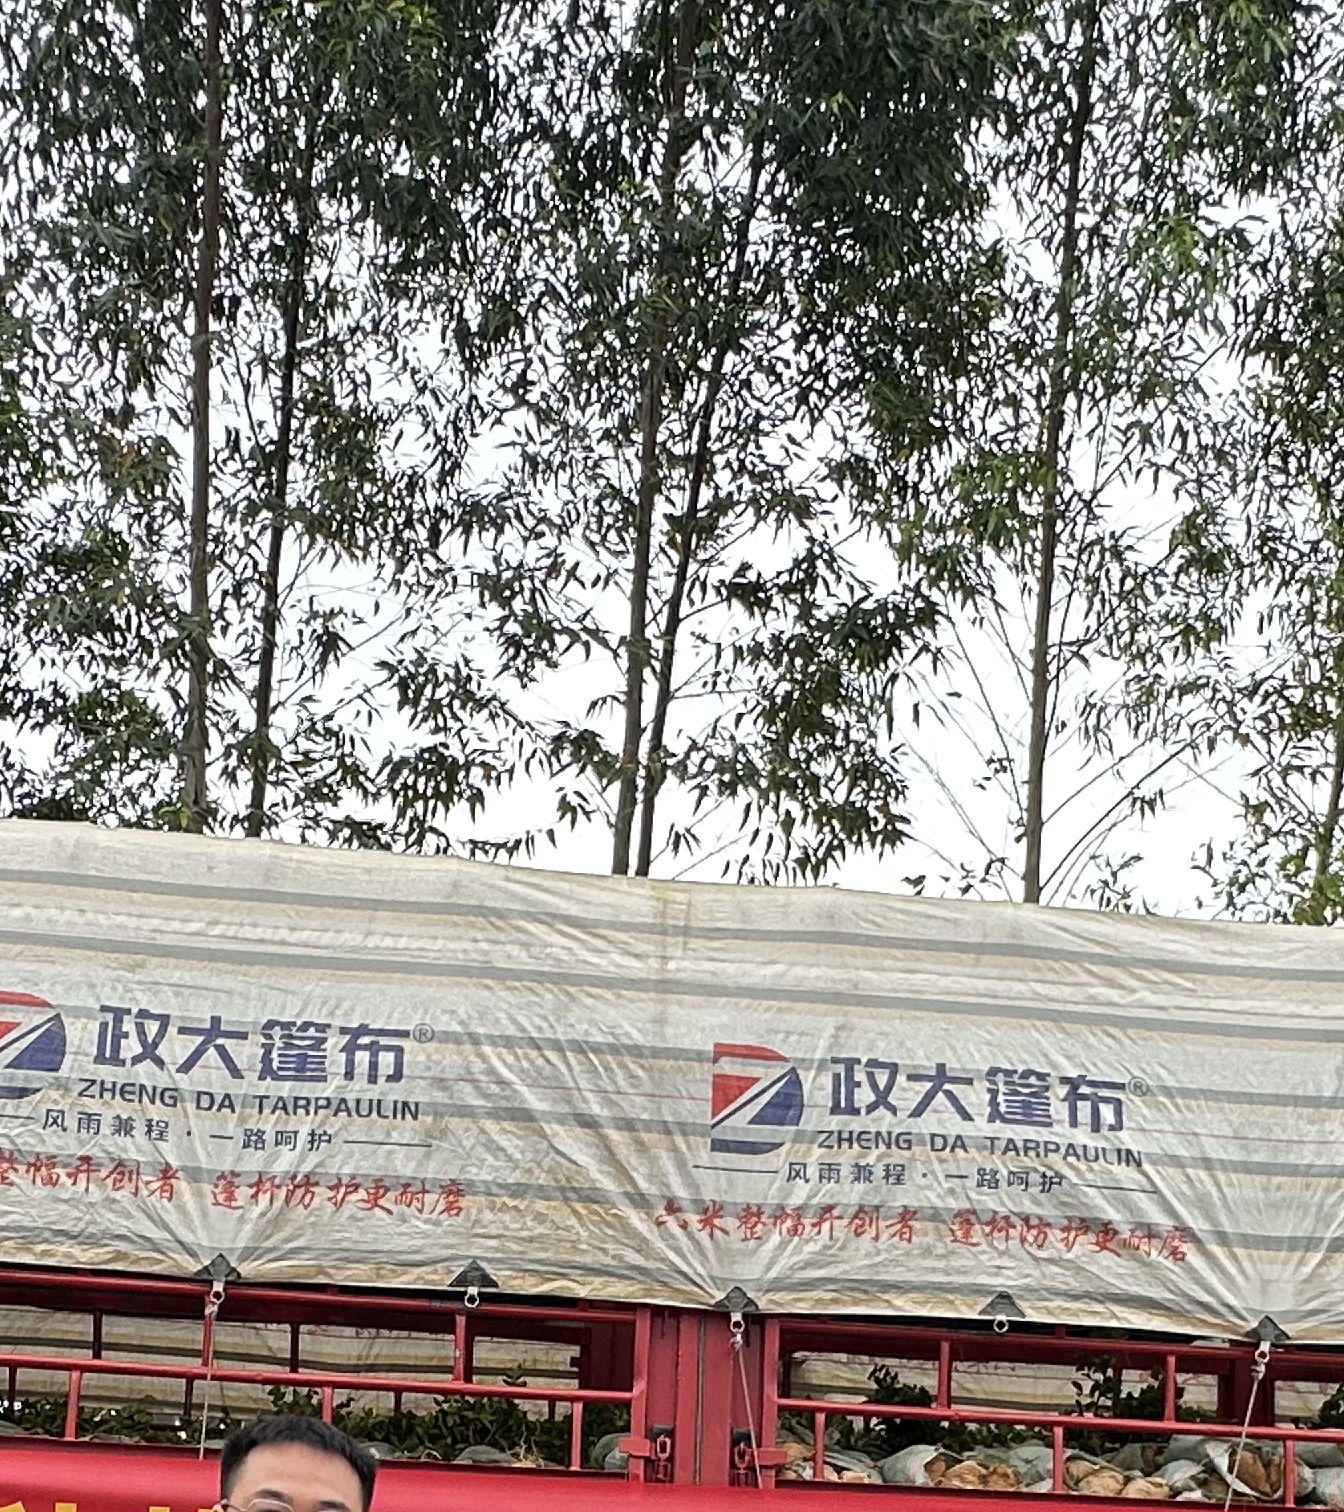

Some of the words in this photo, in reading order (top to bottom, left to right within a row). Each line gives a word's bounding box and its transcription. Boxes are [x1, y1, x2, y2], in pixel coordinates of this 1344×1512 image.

[78, 1078, 179, 1108] ZHENG
[196, 1090, 236, 1114] DA
[256, 1094, 420, 1121] TARPAULIN
[817, 1129, 913, 1152] ZHENG
[930, 1132, 968, 1154] DA
[988, 1136, 1143, 1168] TARPAULIN
